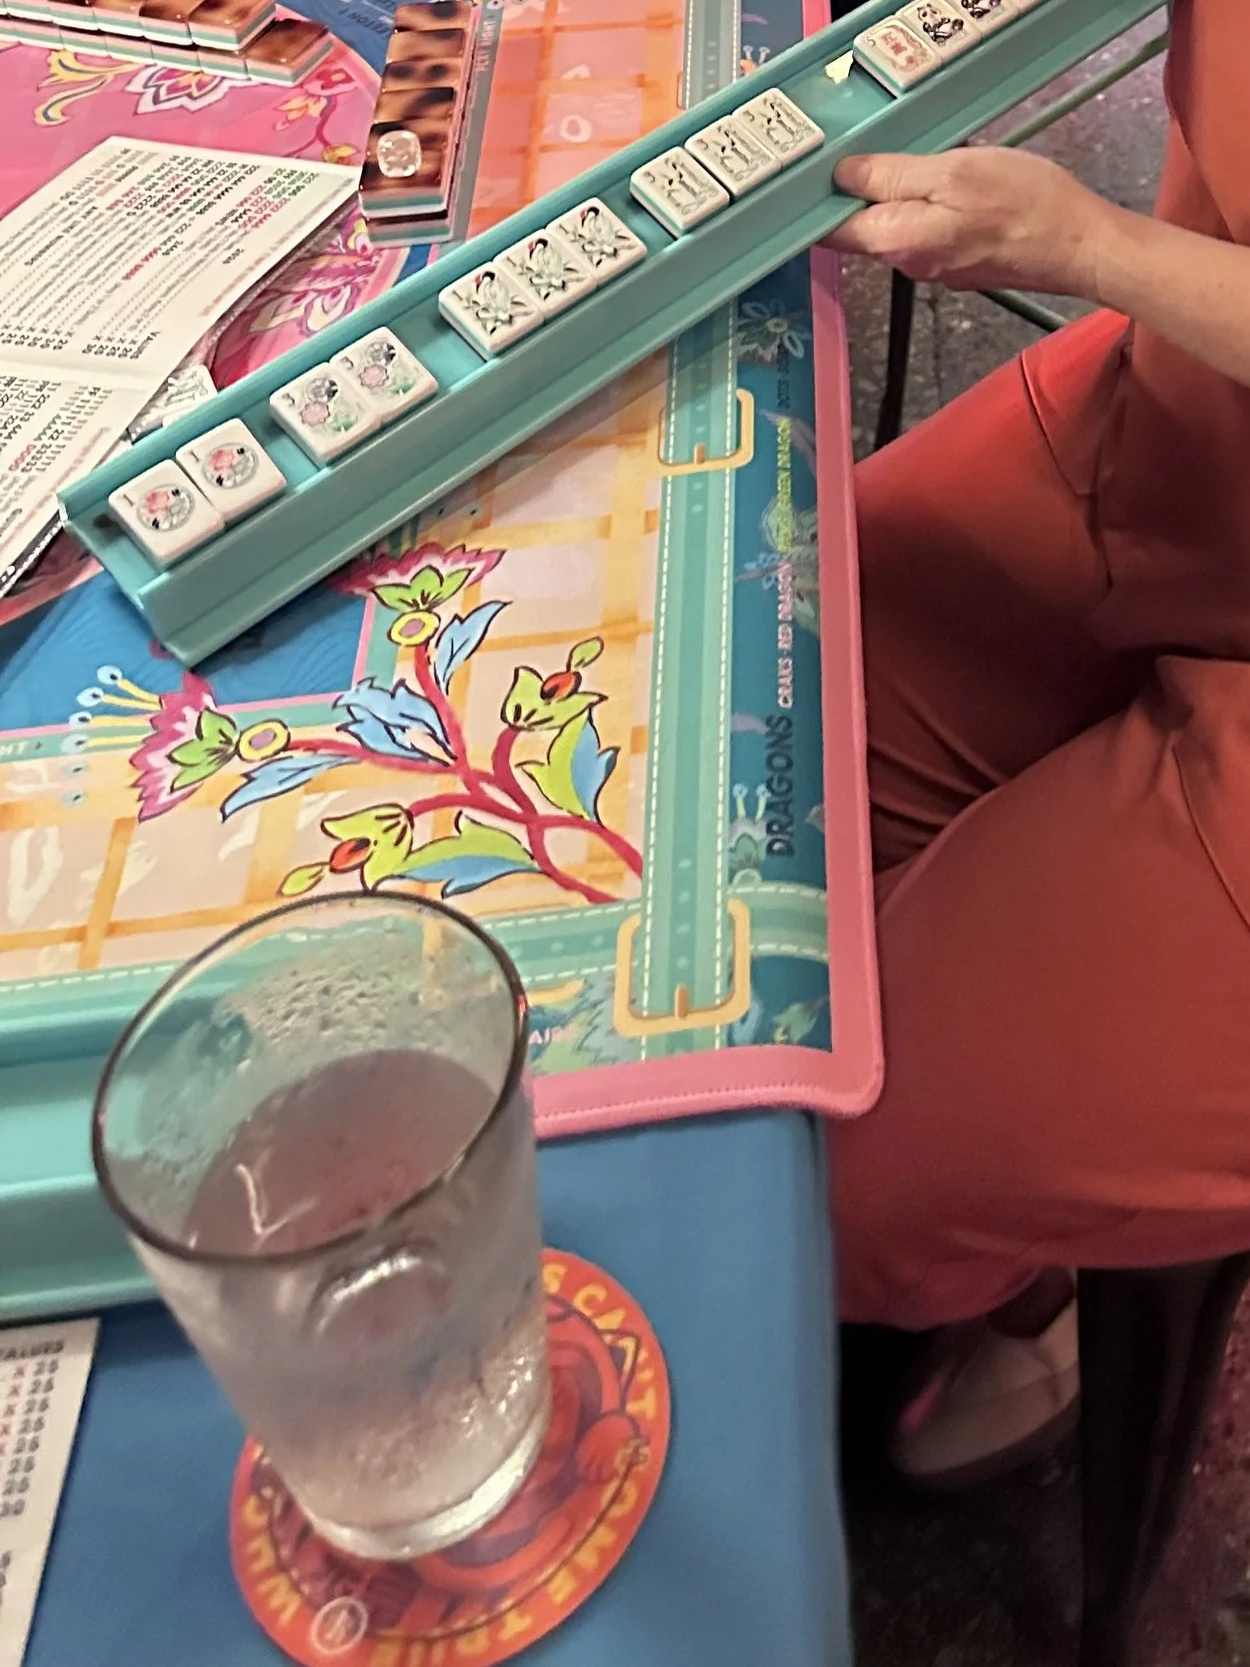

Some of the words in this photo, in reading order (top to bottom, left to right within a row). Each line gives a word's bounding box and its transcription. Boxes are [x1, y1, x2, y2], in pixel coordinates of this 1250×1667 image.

[777, 418, 791, 468] DRAGON
[777, 563, 792, 621] DRAGON
[778, 658, 793, 709] CRAKS
[765, 715, 794, 856] DRAGONS
